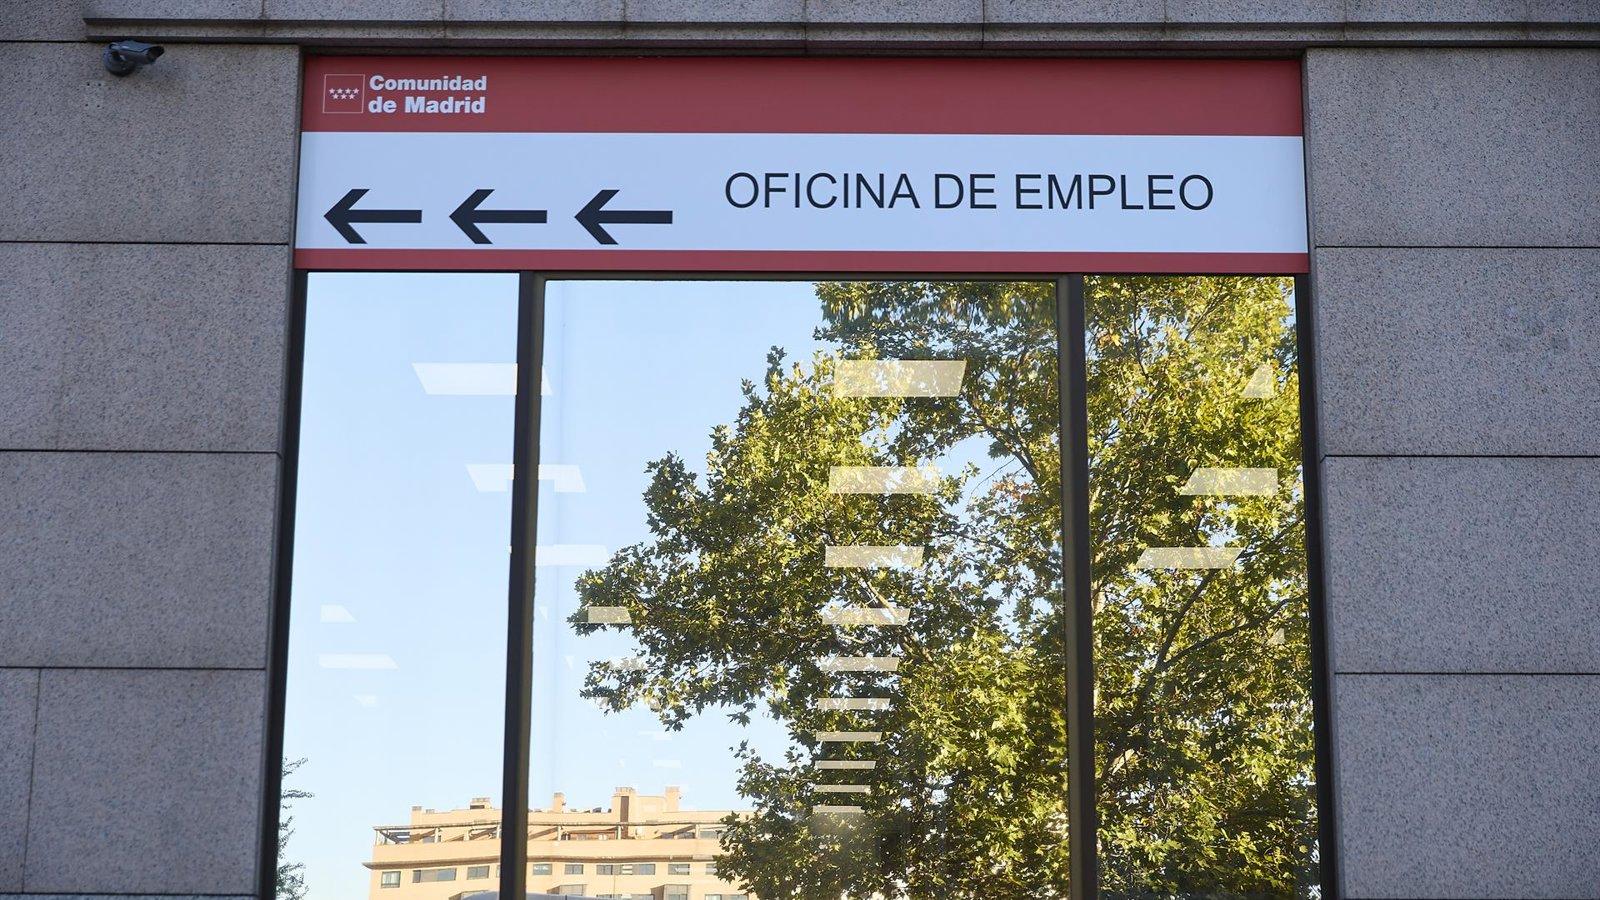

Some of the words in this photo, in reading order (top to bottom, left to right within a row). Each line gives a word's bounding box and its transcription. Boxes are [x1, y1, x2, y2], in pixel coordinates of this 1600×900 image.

[369, 75, 487, 92] Comunidad
[368, 96, 397, 114] de
[404, 96, 486, 114] Madrid
[725, 172, 921, 210] OFICINA
[934, 173, 997, 210] DE
[1015, 173, 1214, 211] EMPLEO
